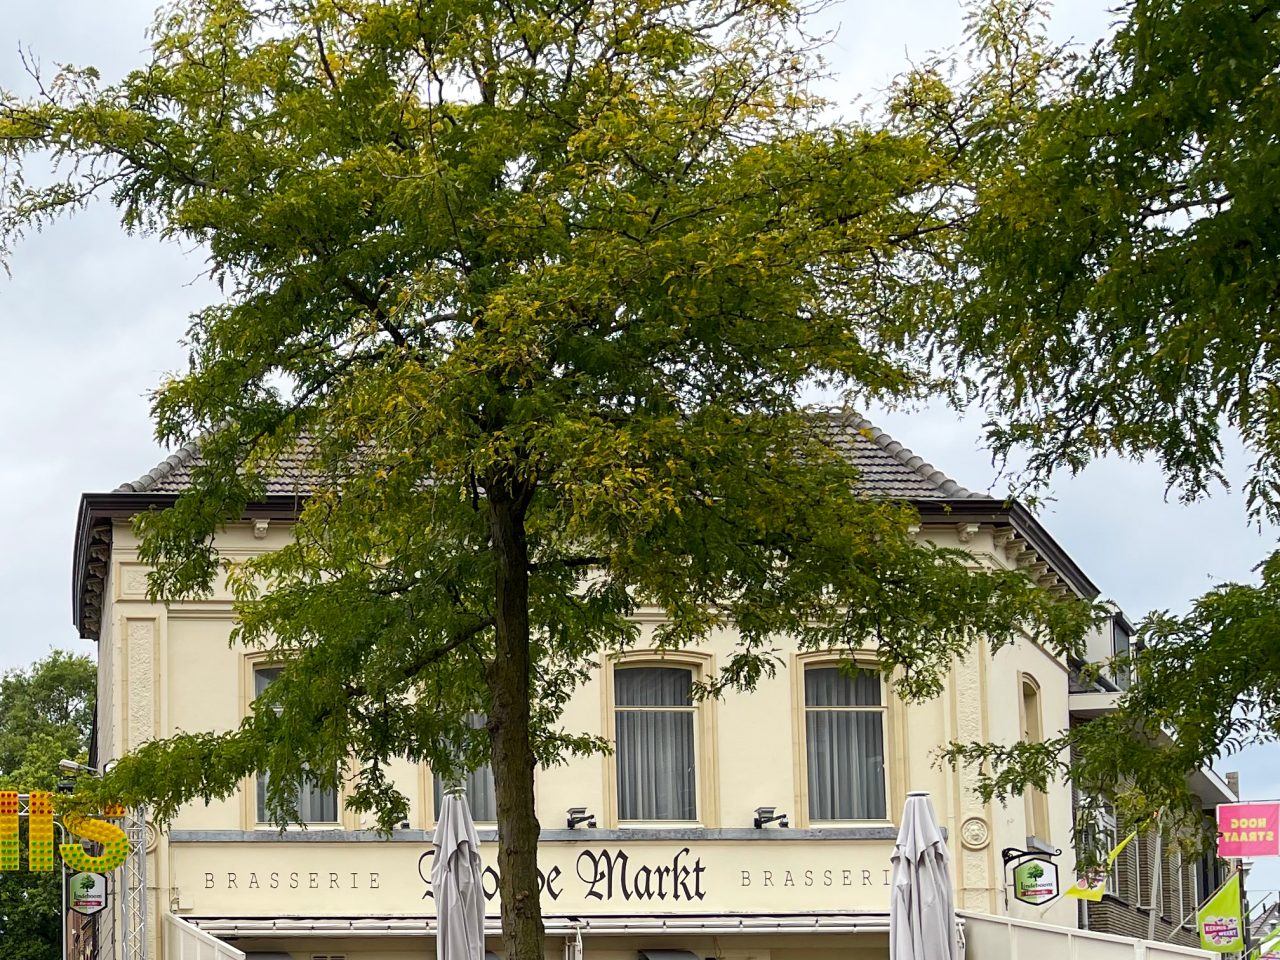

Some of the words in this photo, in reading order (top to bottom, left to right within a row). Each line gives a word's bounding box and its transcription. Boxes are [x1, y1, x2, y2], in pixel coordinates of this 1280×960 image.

[204, 871, 380, 889] BRASSERIE
[576, 847, 707, 901] Markt
[740, 869, 891, 887] BRASSERI
